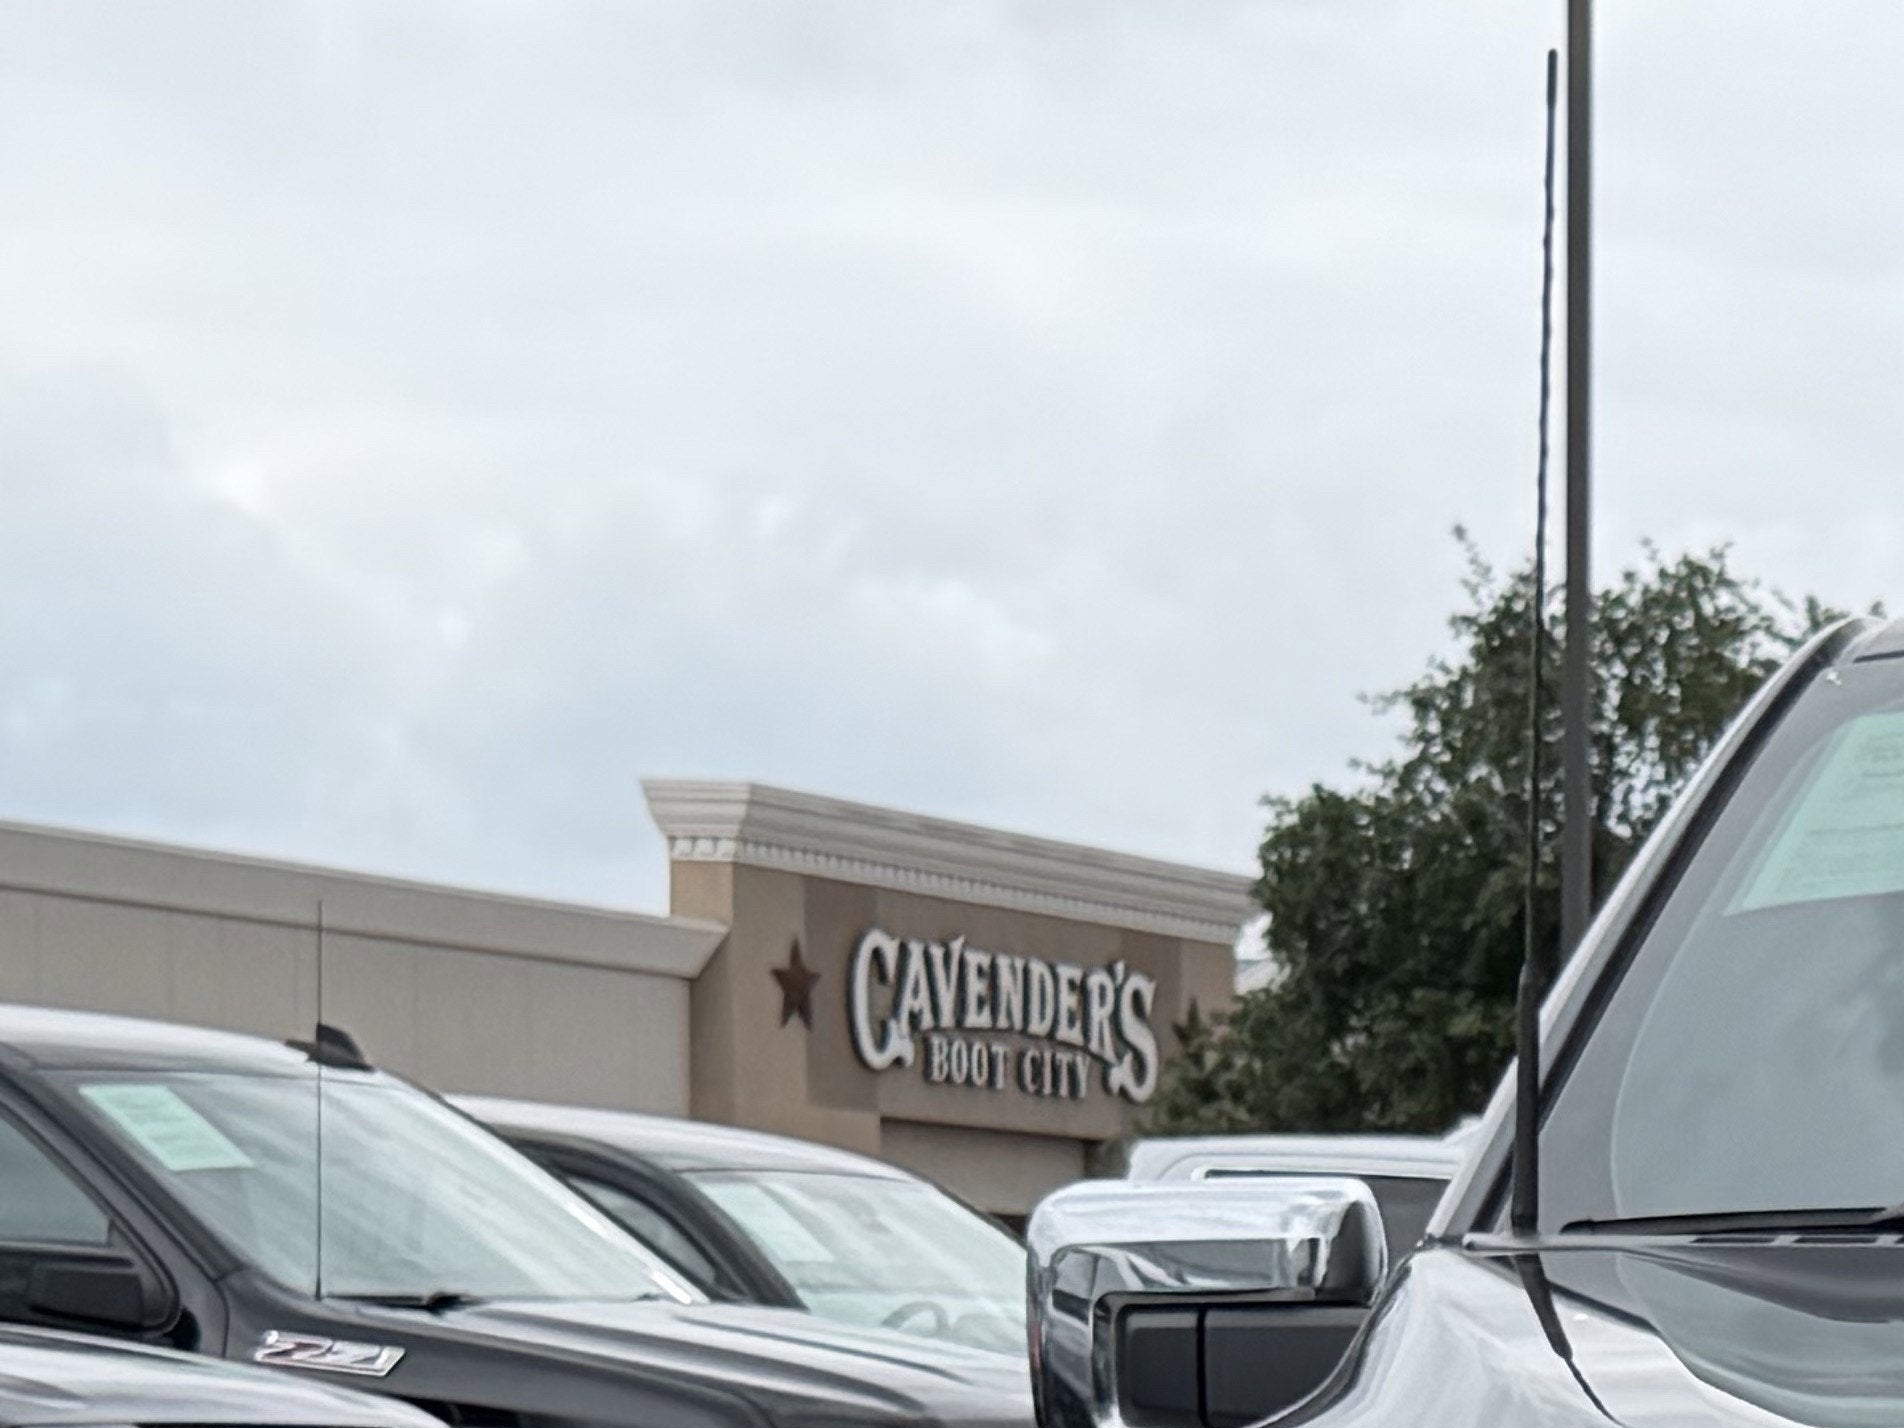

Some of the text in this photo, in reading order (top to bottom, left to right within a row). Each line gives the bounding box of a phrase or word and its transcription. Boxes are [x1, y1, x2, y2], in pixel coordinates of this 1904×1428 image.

[852, 927, 1159, 1102] CAVENDER'S
[930, 1033, 1091, 1099] BOOT CITY
